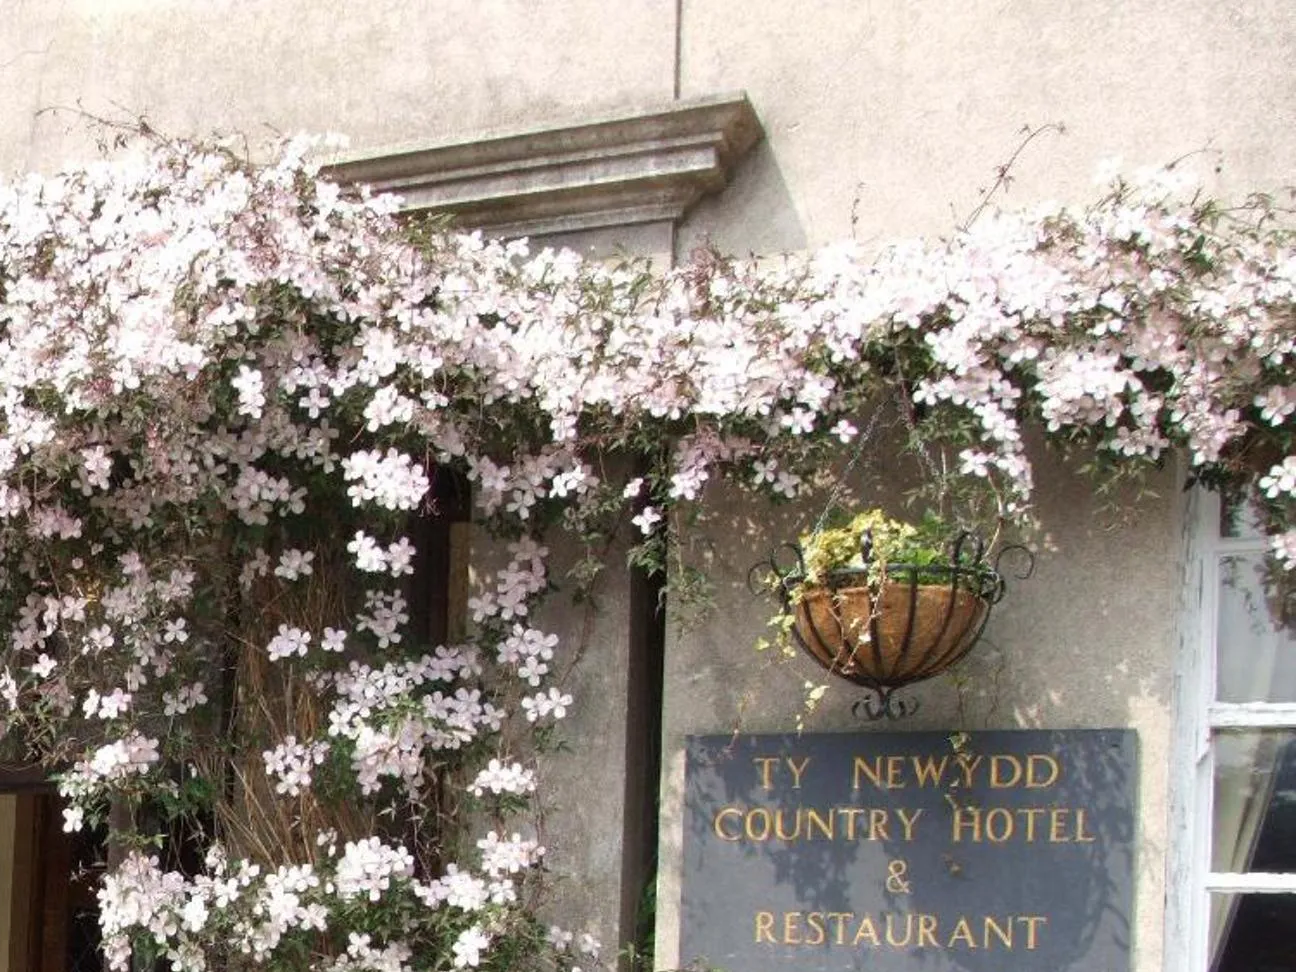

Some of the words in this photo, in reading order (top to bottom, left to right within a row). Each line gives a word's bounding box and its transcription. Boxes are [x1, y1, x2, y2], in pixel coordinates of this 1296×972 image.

[752, 756, 812, 791] TY
[851, 753, 1061, 790] NEWYDD
[711, 806, 924, 844] COUNTRY
[951, 807, 1097, 844] HOTEL
[885, 858, 913, 895] &
[753, 910, 1048, 951] RESTAURANT
